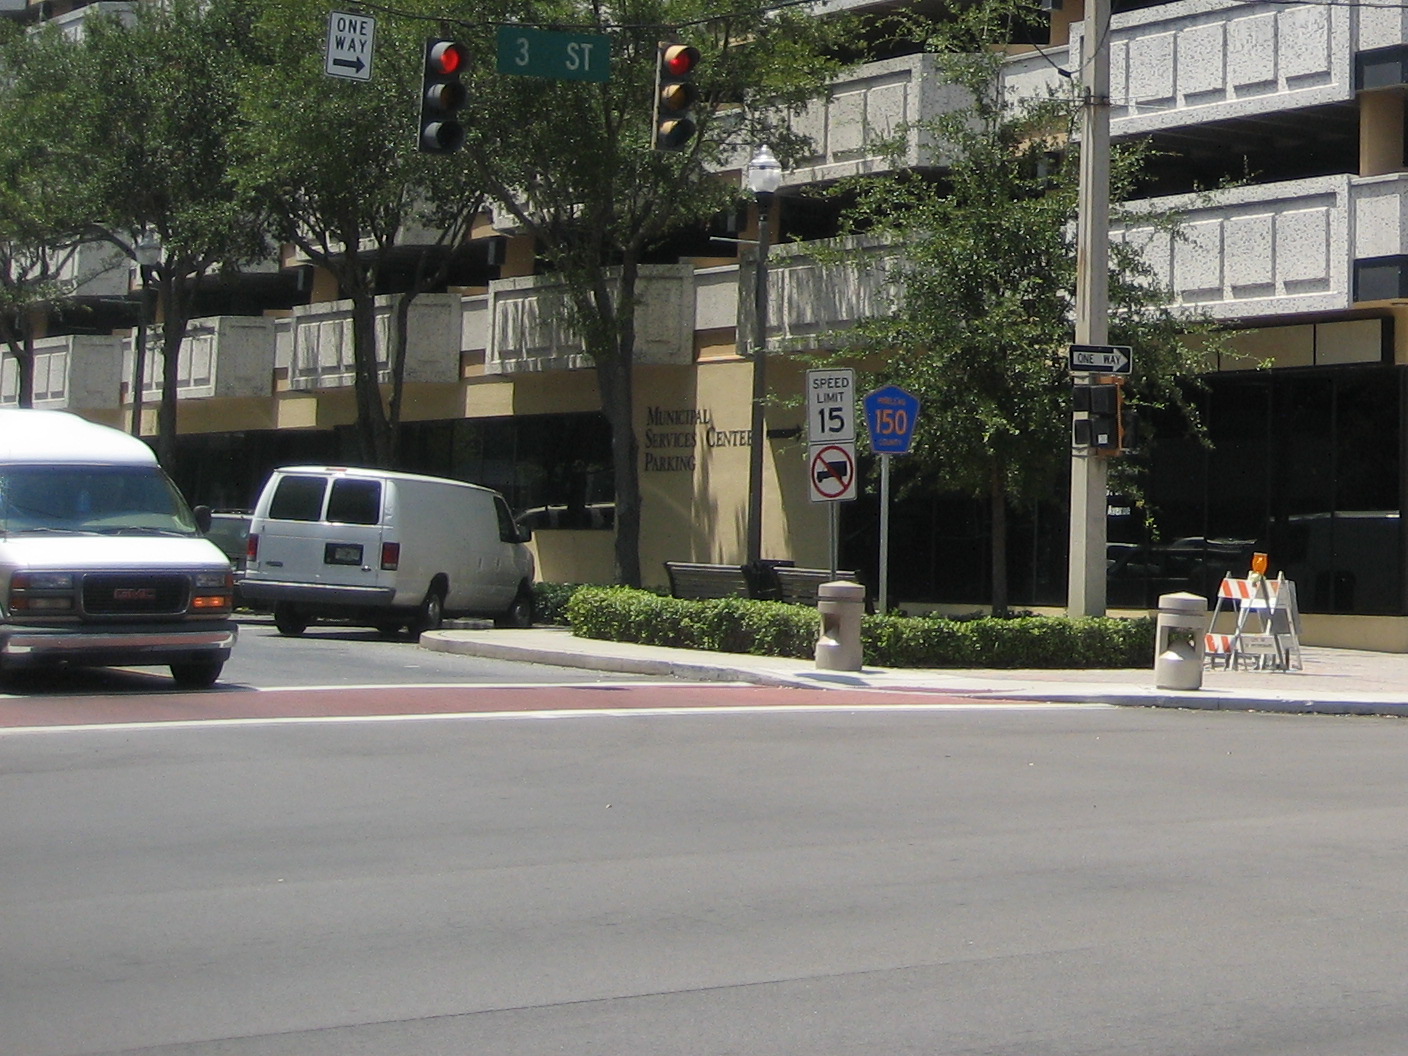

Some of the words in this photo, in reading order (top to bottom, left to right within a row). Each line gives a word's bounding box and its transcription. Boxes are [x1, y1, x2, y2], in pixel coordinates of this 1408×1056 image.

[336, 17, 368, 36] ONE
[335, 35, 368, 54] WAY
[515, 37, 530, 66] 3
[565, 42, 593, 71] ST
[1078, 353, 1095, 364] ONE
[1103, 355, 1121, 365] WAY
[813, 377, 849, 390] SPEED
[816, 392, 845, 404] LIMIT
[646, 406, 711, 425] MUNICIPAL
[818, 407, 845, 434] 15
[875, 409, 908, 435] 150
[645, 429, 696, 448] SERVICES
[644, 452, 695, 472] PARKING
